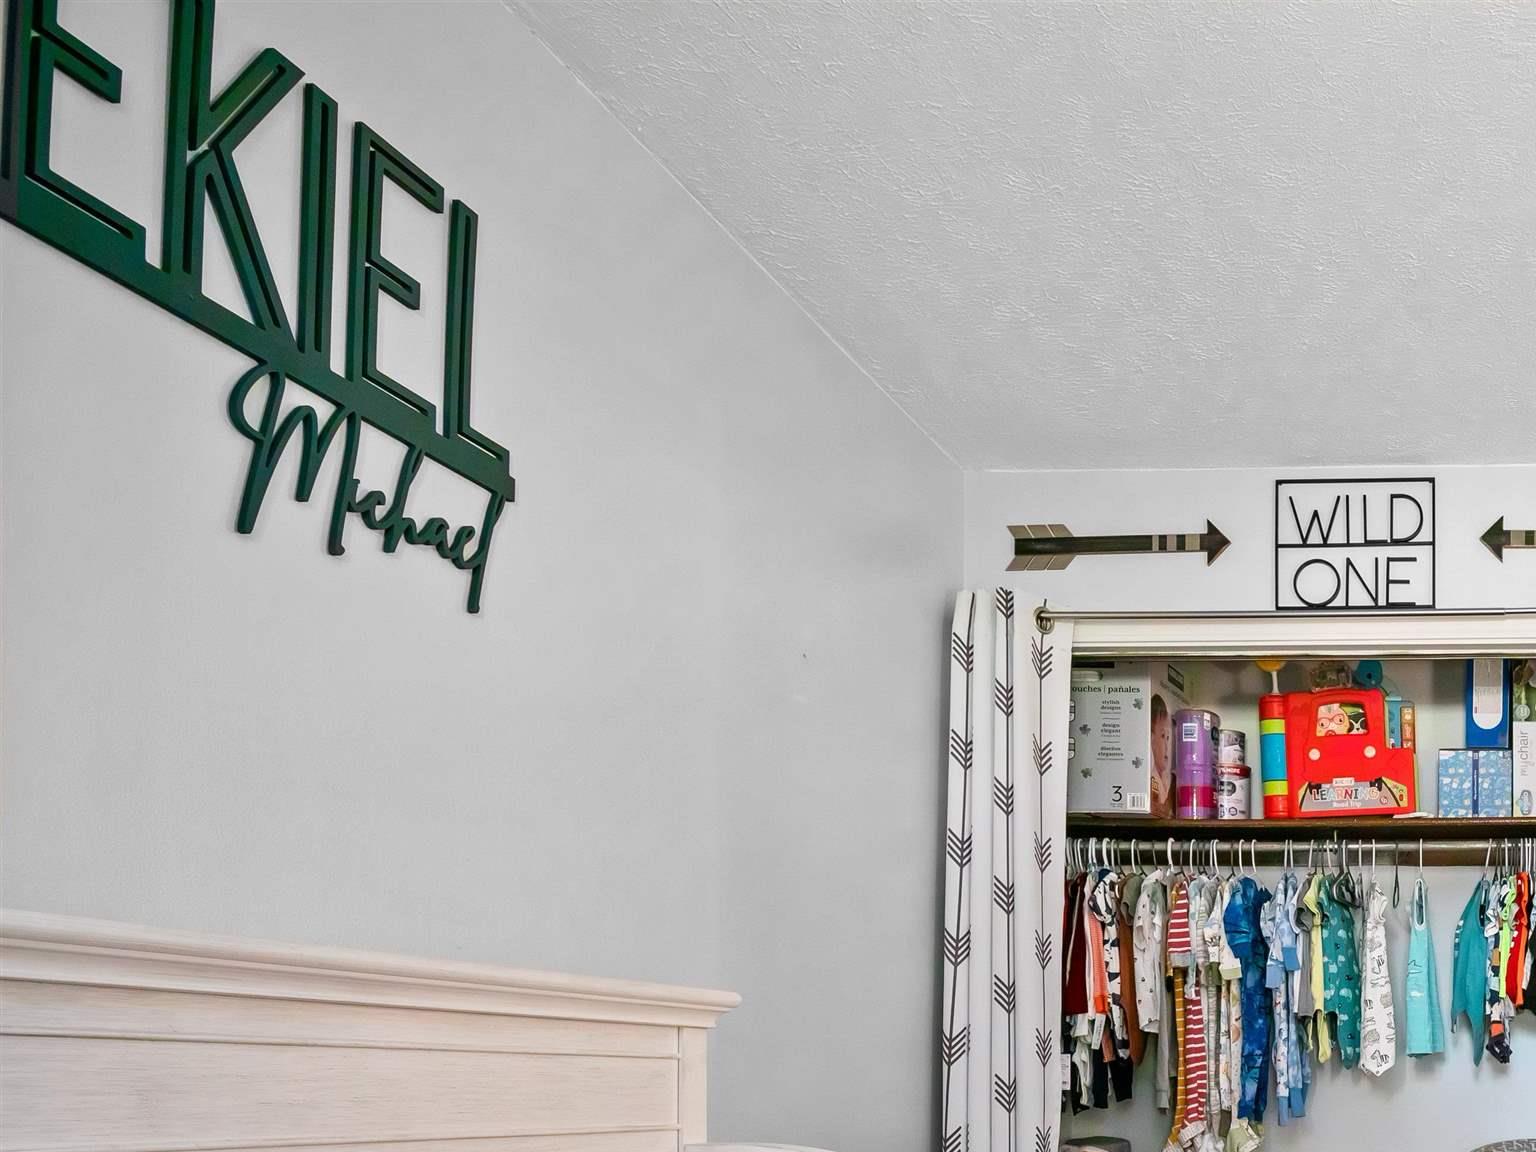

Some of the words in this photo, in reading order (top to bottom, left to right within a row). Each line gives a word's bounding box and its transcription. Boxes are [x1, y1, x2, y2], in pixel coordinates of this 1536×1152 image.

[229, 362, 510, 614] Michael
[1288, 493, 1424, 544] WILD
[1293, 557, 1417, 607] ONE
[1072, 685, 1102, 693] ouches
[1107, 685, 1141, 694] pañales
[1517, 731, 1535, 776] mychair
[1112, 785, 1123, 802] 3
[1312, 786, 1380, 801] LEARNING
